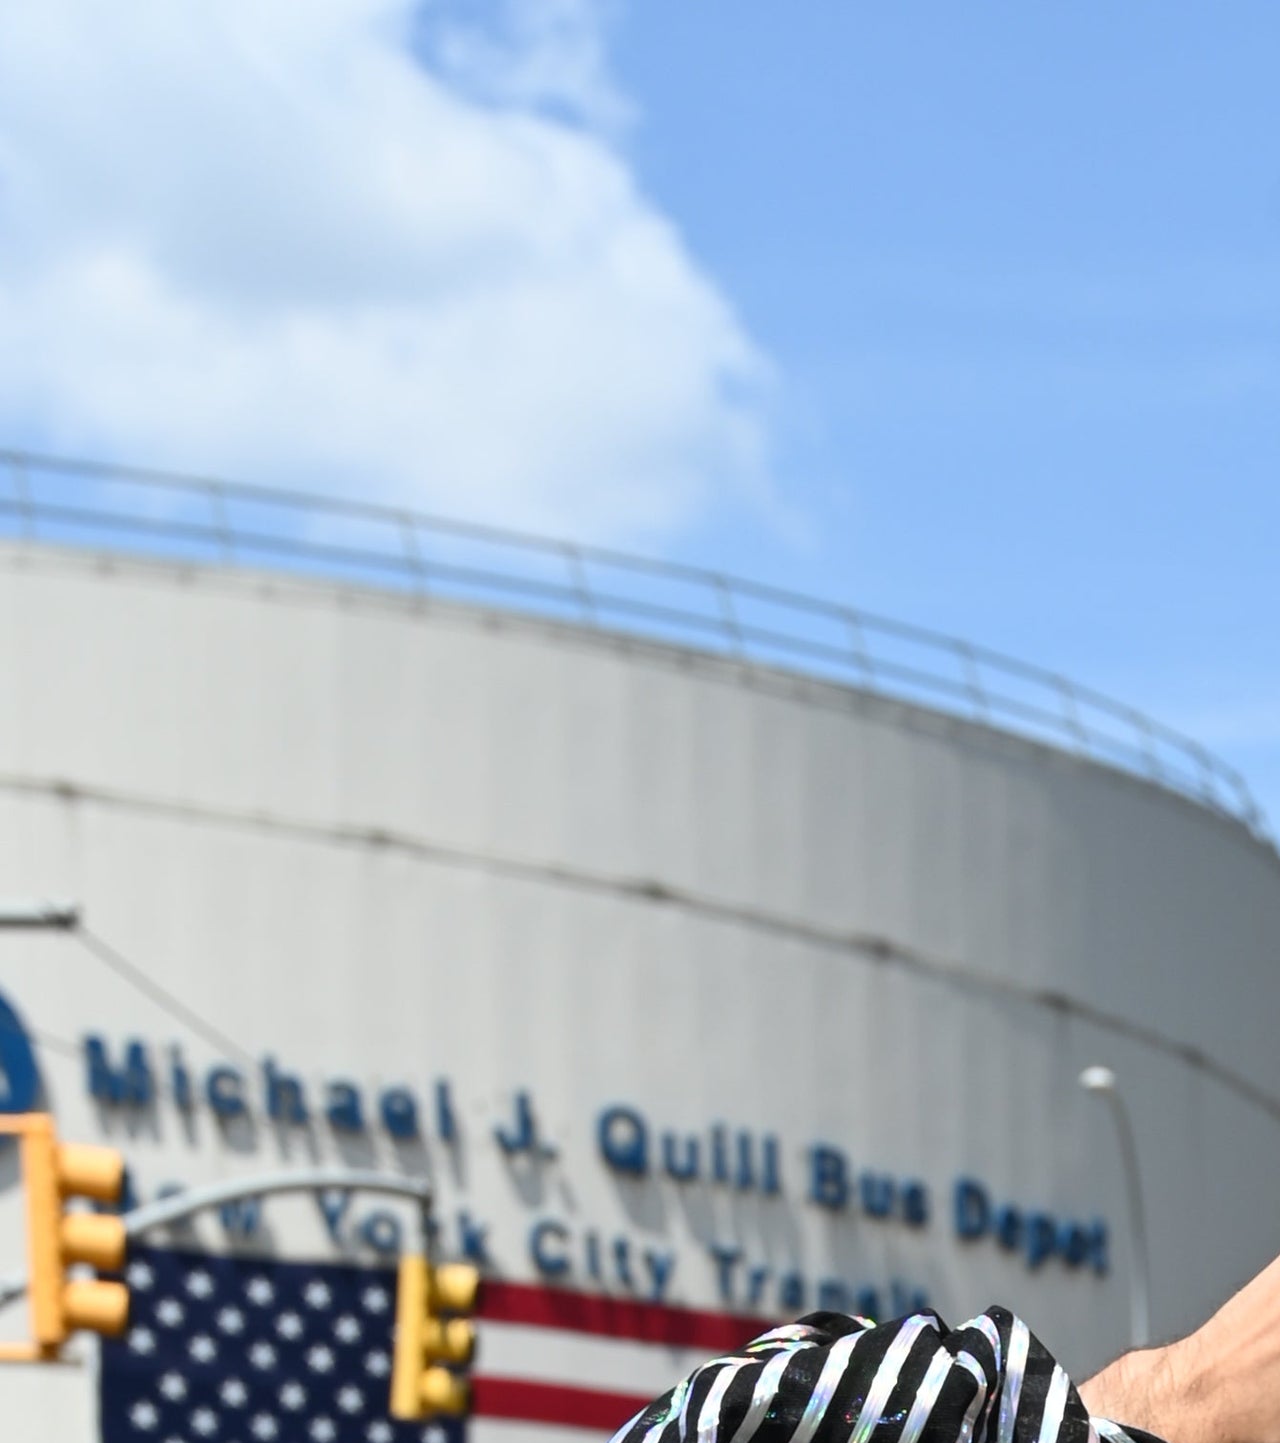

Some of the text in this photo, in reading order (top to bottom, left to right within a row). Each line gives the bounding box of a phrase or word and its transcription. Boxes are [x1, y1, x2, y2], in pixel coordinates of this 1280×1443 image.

[83, 1032, 1112, 1278] Michael J. Quill Bus Depot
[528, 1214, 678, 1306] City
